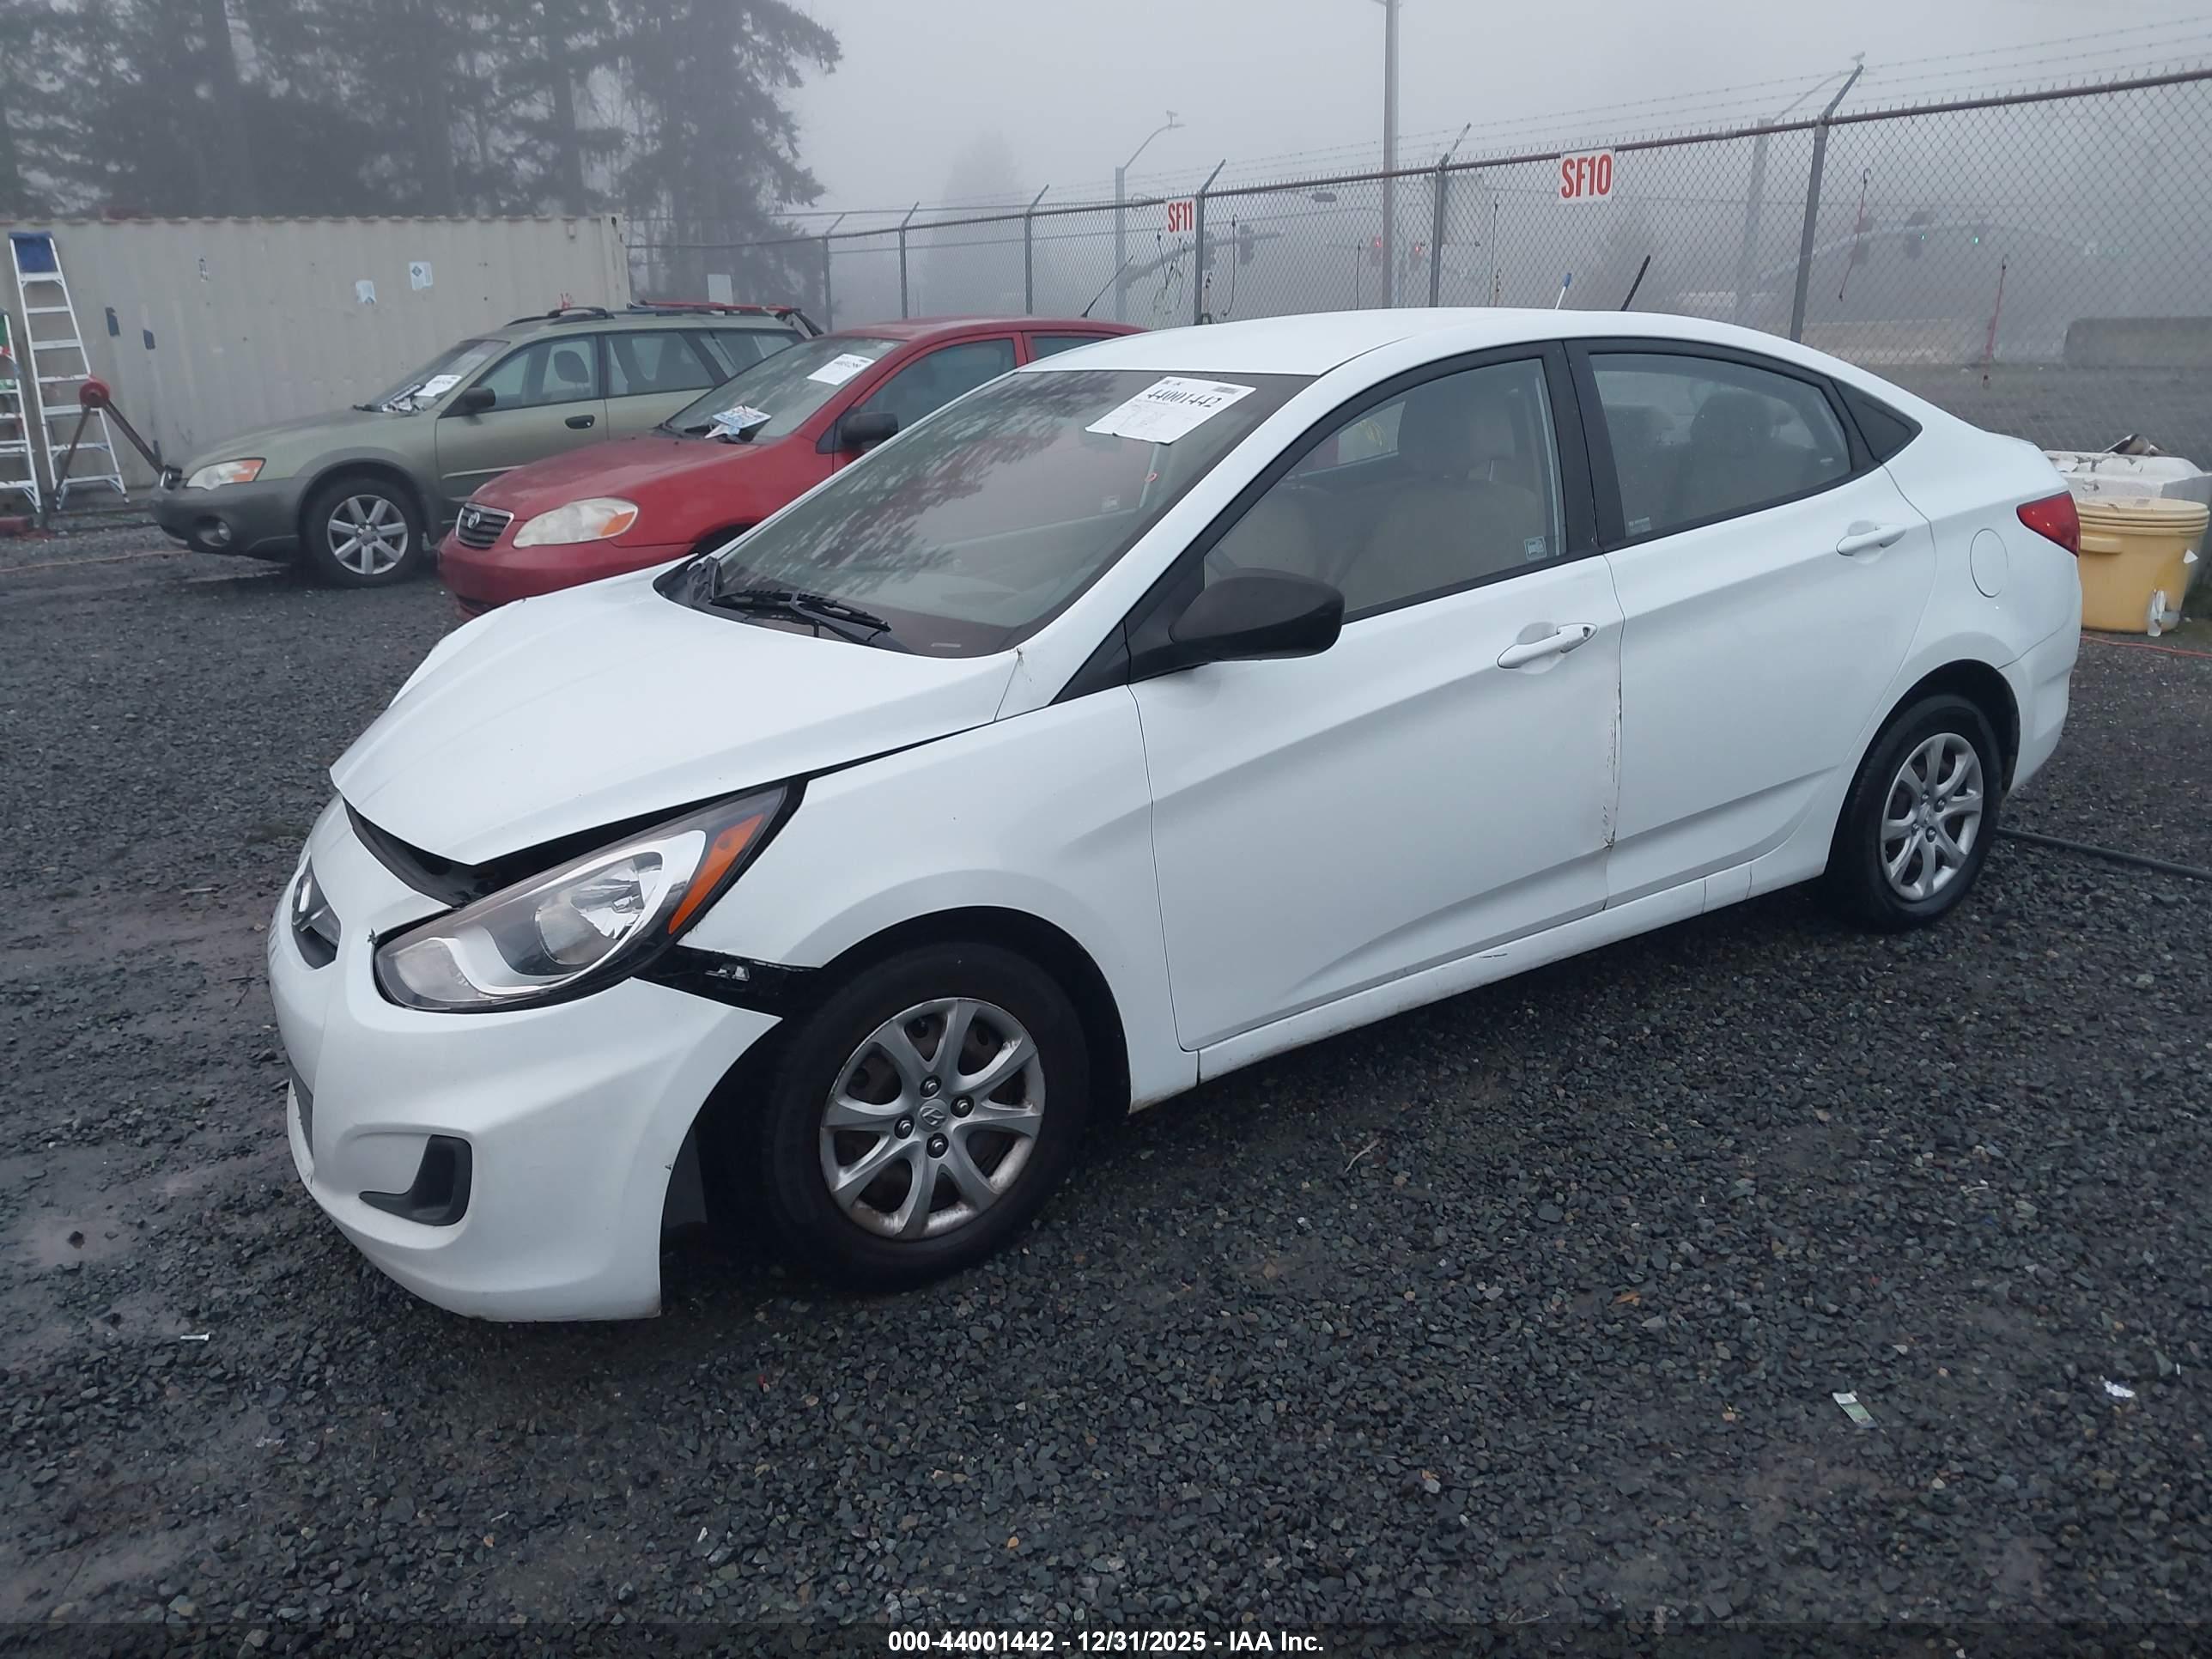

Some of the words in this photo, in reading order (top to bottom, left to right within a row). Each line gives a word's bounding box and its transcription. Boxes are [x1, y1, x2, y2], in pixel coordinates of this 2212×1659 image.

[1561, 154, 1612, 199] SF10
[1168, 201, 1193, 233] SF11
[1148, 388, 1223, 408] 44001442
